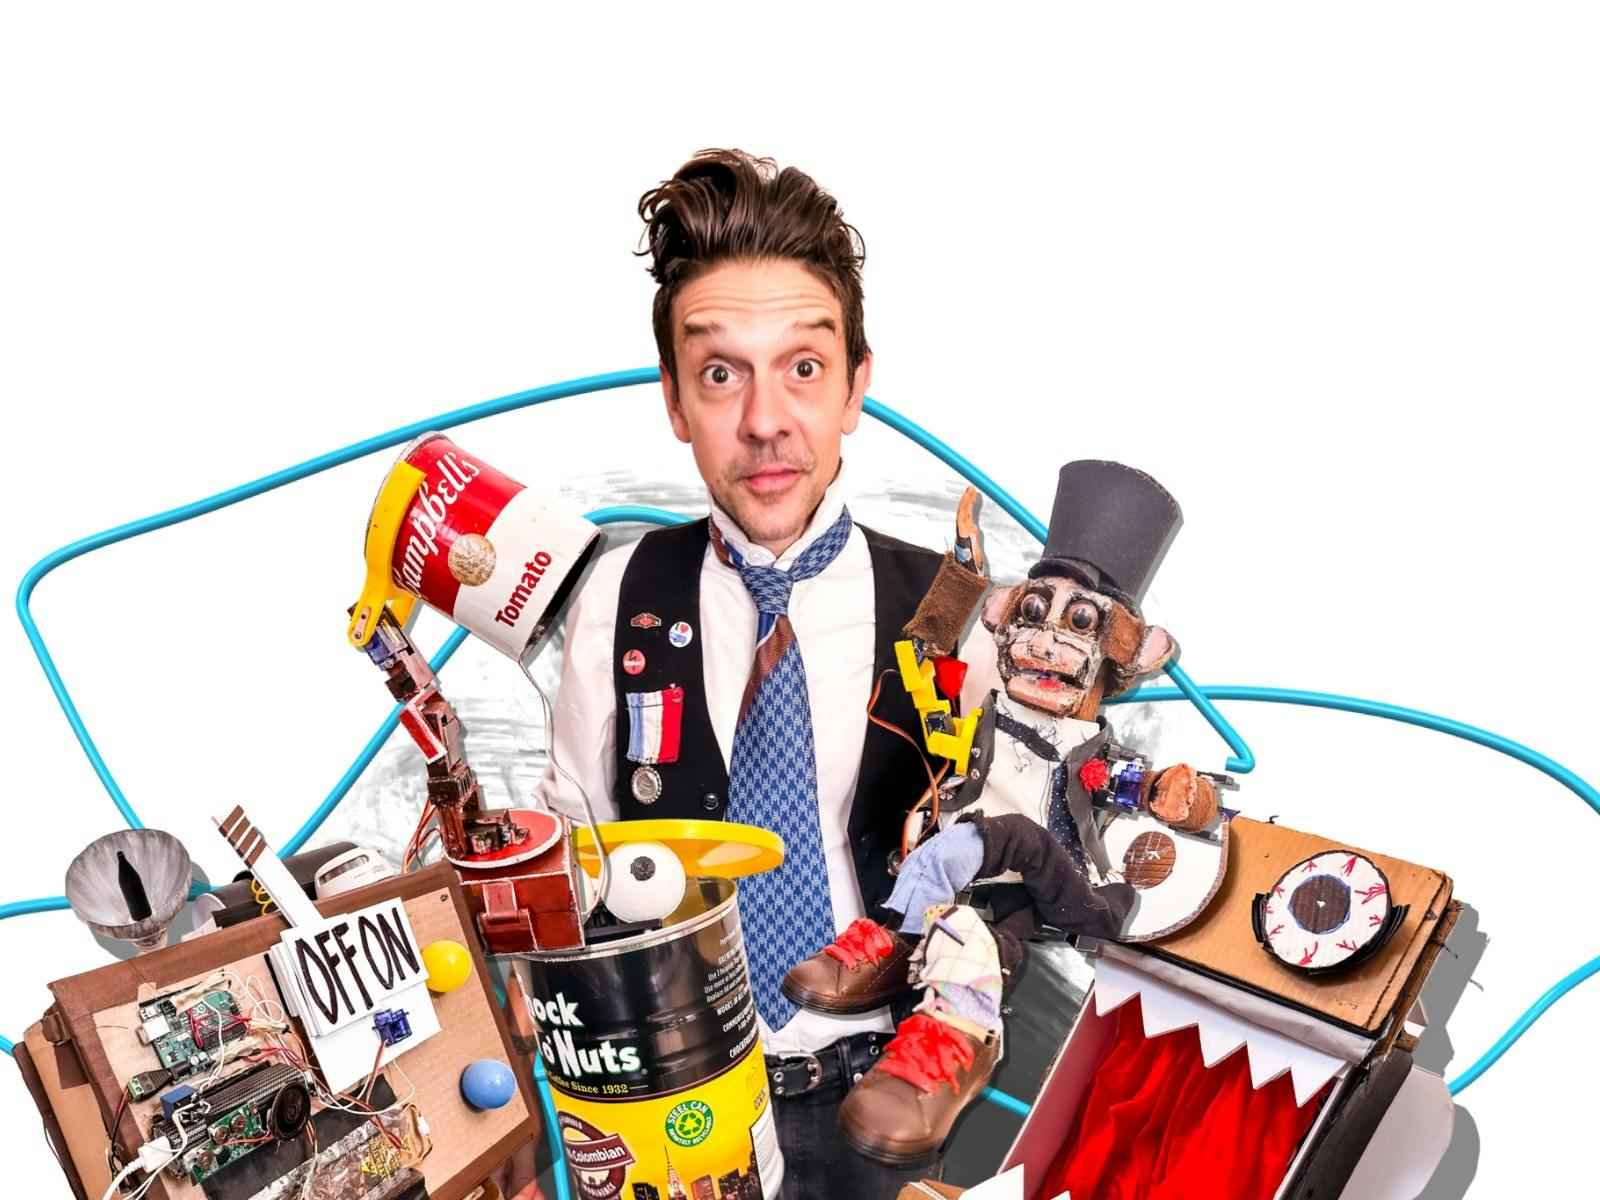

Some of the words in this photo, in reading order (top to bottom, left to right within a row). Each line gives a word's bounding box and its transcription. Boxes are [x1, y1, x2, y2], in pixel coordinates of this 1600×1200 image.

[495, 551, 552, 628] Tomato
[295, 922, 374, 1025] OFF
[358, 907, 420, 990] ON
[530, 992, 584, 1027] ock
[570, 1079, 599, 1094] Since
[602, 1083, 629, 1094] 1932
[668, 1103, 689, 1124] STEEL
[690, 1101, 708, 1114] CAN
[573, 1146, 626, 1163] Colombian
